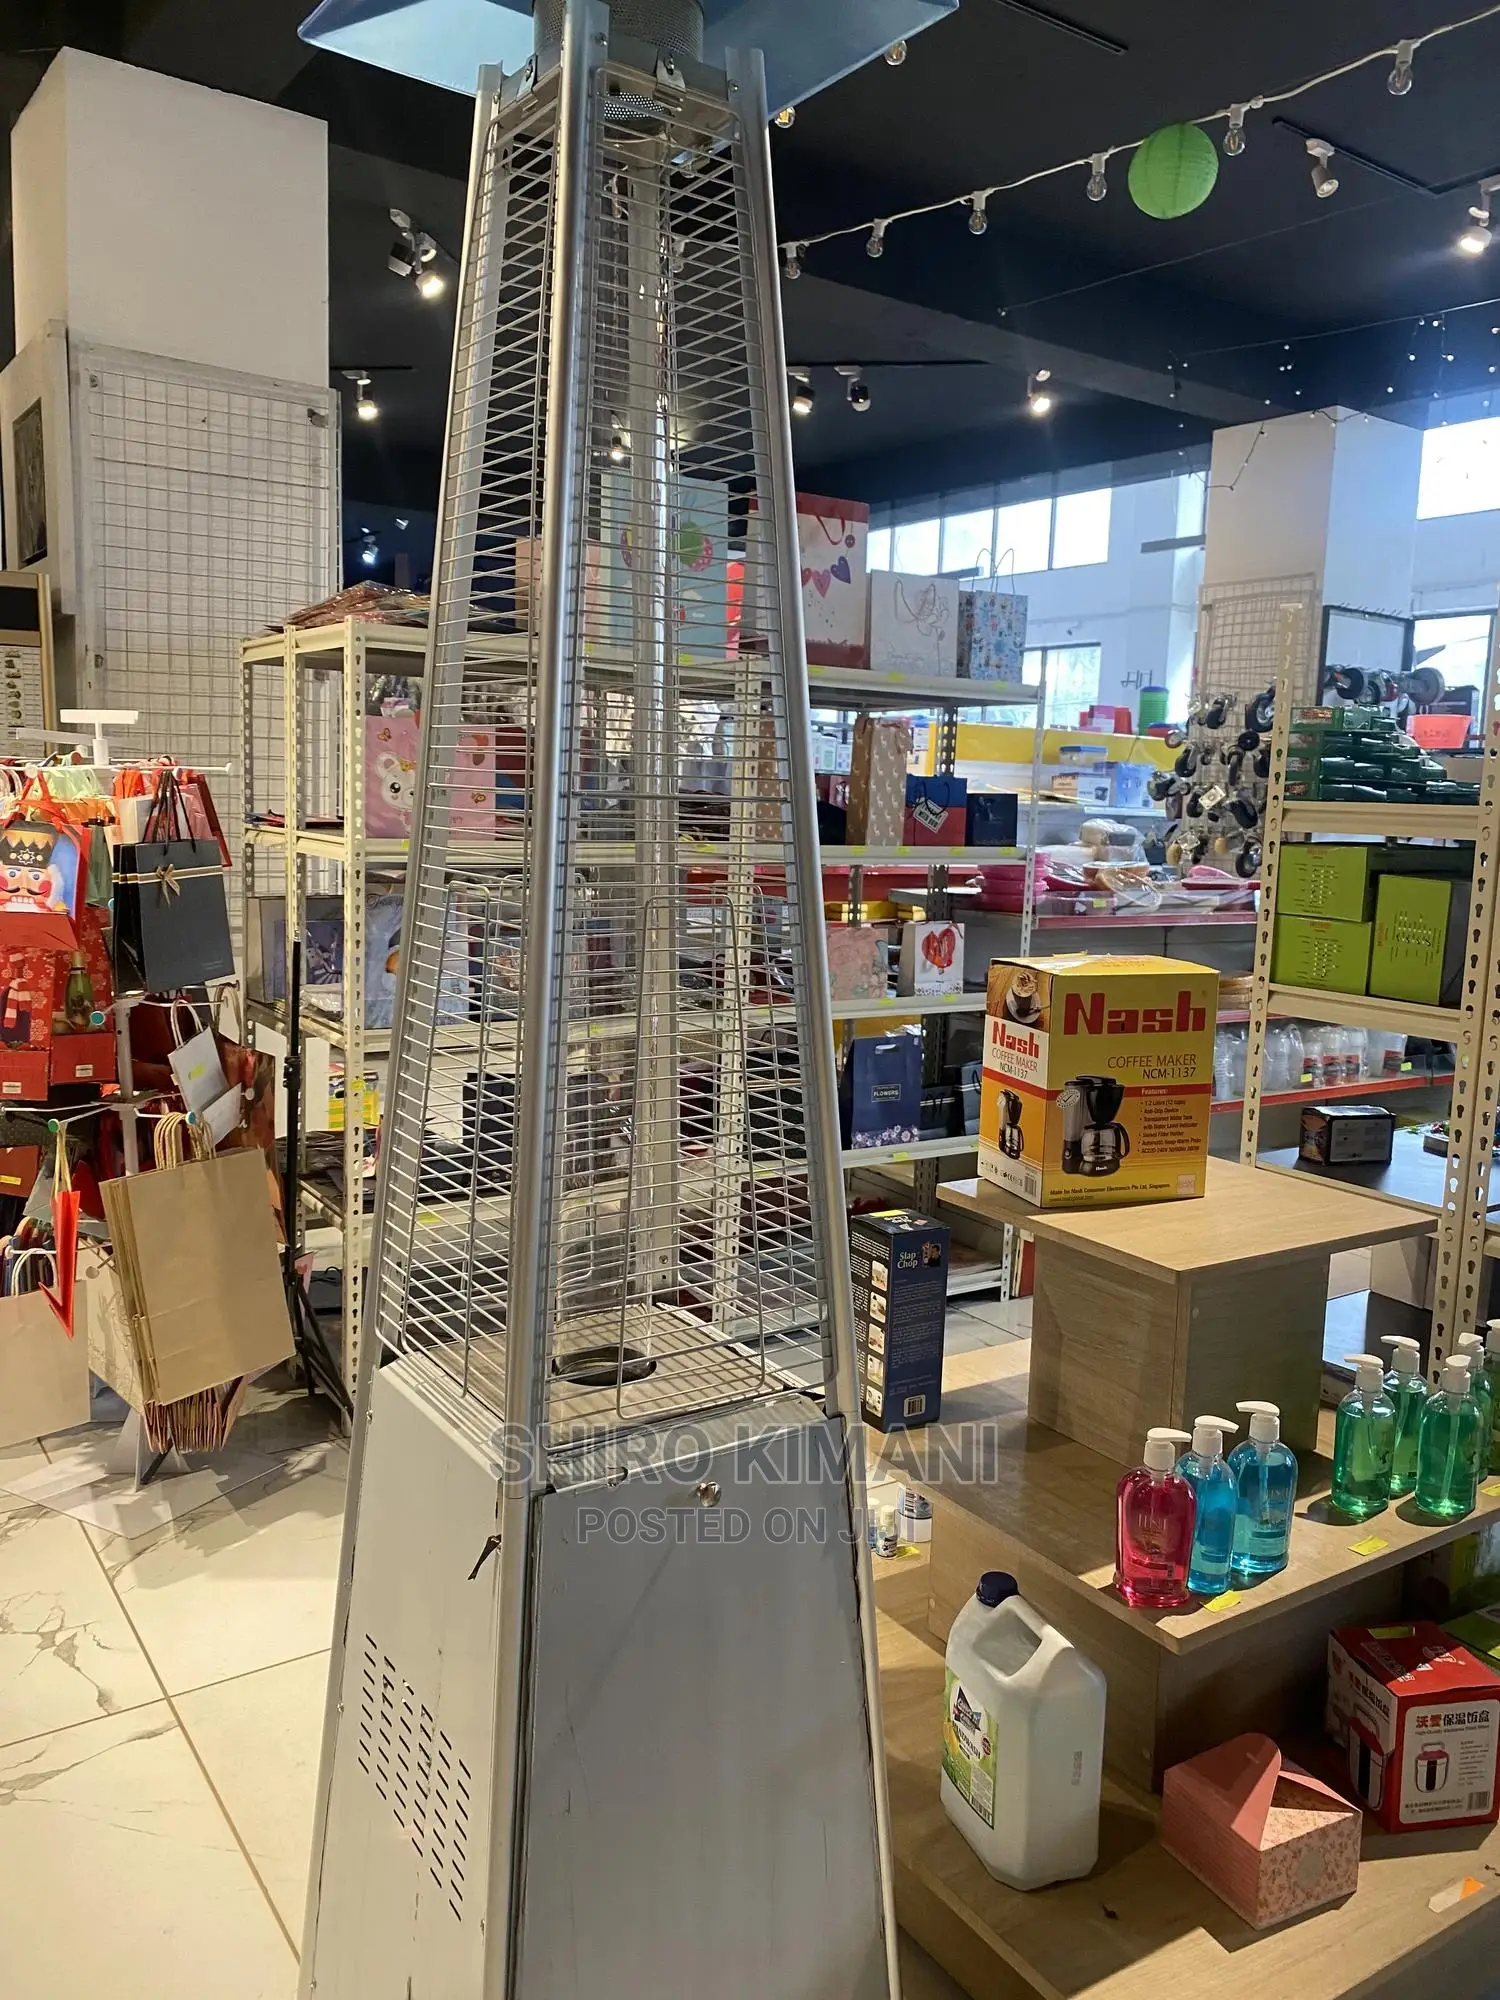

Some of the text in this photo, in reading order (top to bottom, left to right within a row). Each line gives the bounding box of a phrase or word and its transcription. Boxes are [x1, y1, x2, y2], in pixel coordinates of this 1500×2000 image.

[1063, 990, 1207, 1035] Nash
[992, 1021, 1040, 1059] Nash
[991, 1047, 1038, 1073] COFFEE MAKER
[1107, 1053, 1197, 1069] COFFEE MAKER
[1000, 1062, 1028, 1080] NCM-1137
[1142, 1067, 1197, 1079] NCM-1137
[897, 1259, 918, 1269] Chop
[899, 1251, 917, 1262] Slap
